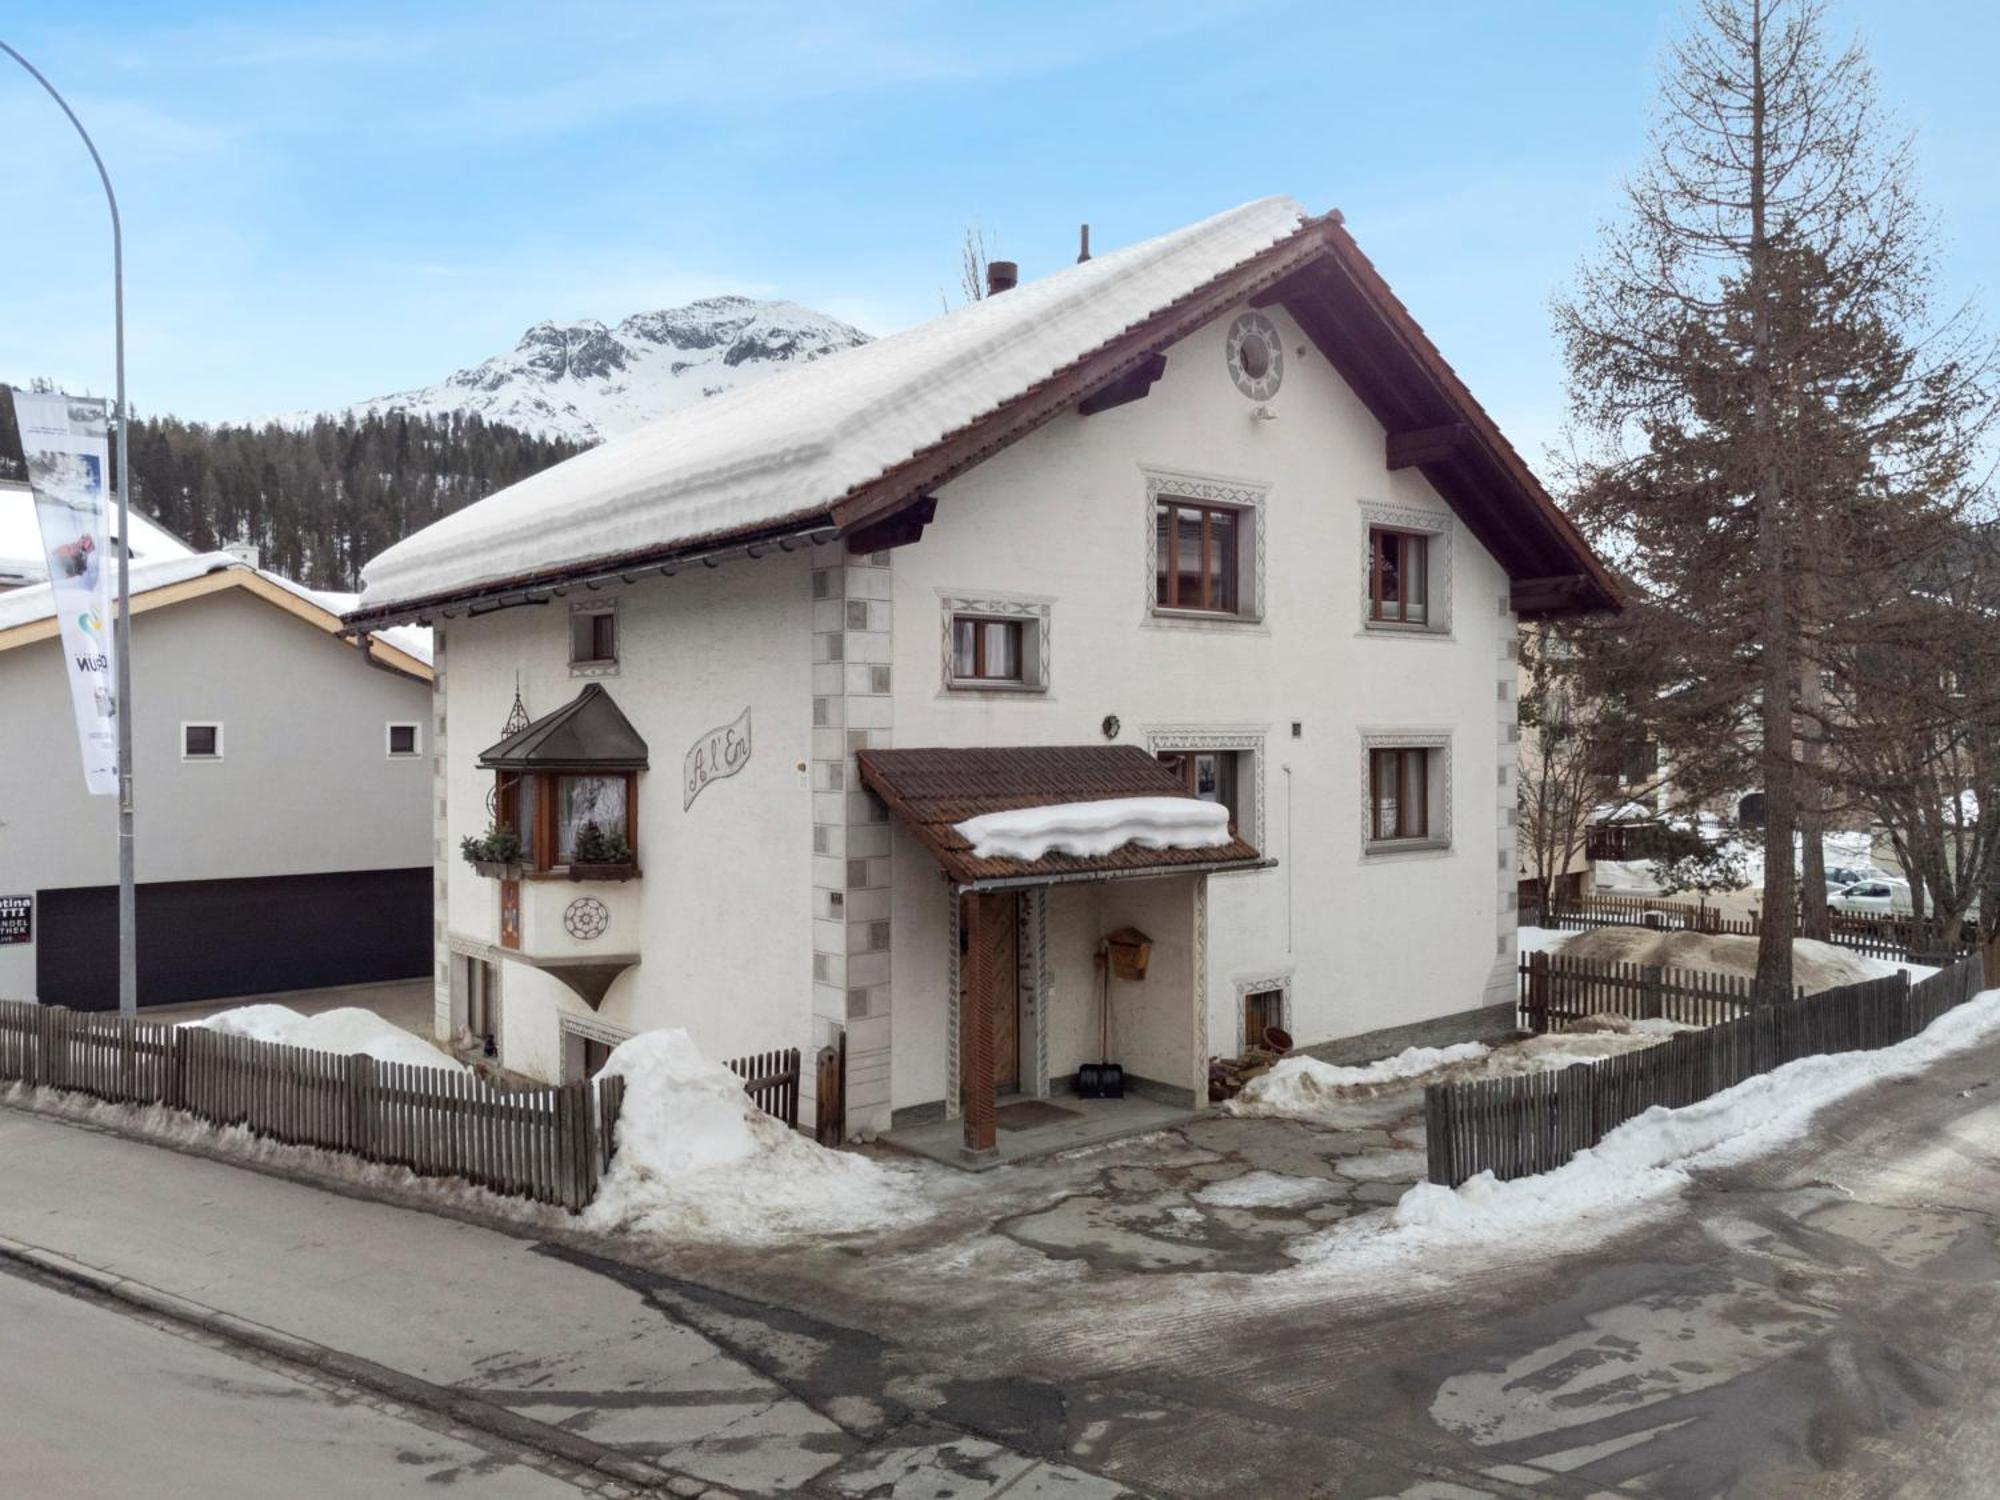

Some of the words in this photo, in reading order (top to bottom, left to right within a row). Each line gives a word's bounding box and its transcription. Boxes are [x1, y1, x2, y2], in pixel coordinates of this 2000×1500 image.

[0, 899, 31, 908] tina
[0, 908, 25, 918] TTI
[0, 927, 26, 935] THEK
